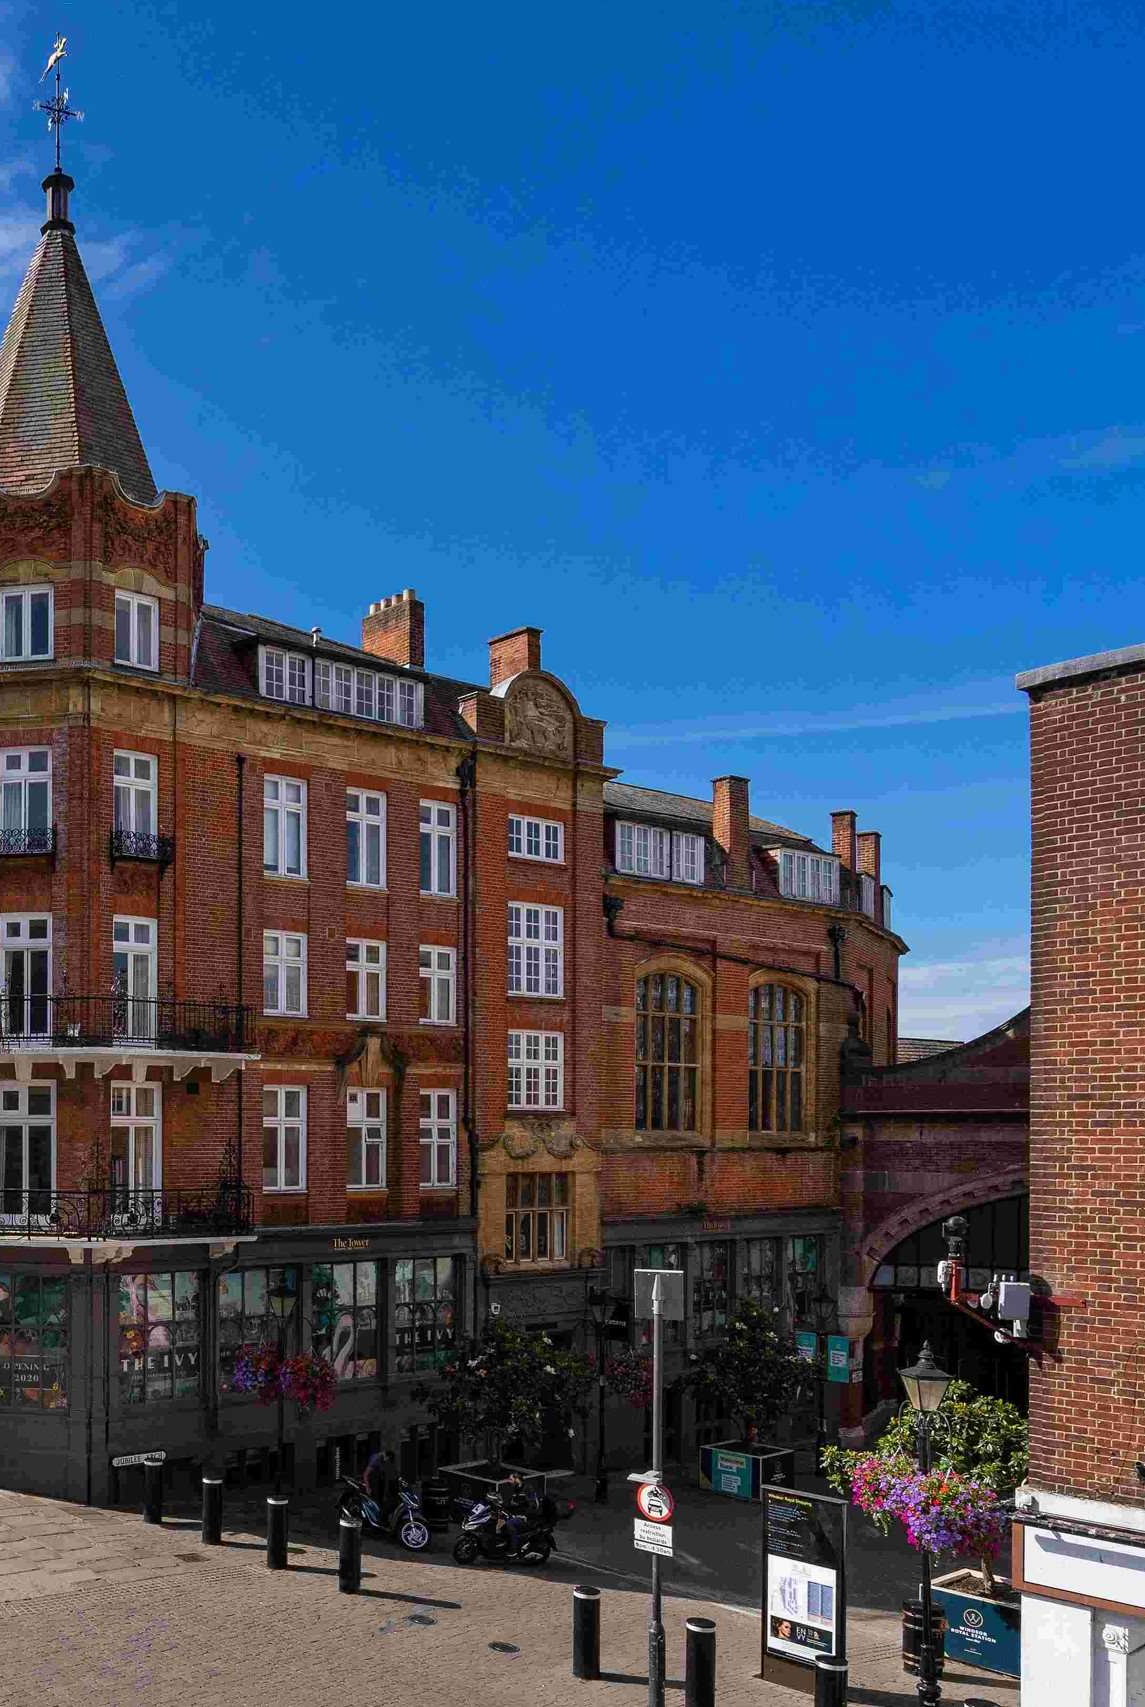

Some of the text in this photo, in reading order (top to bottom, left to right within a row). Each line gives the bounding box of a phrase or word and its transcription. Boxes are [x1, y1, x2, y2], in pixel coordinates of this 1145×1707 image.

[332, 1238, 346, 1249] The
[395, 1328, 455, 1345] THE IVY
[120, 1351, 198, 1373] THE IVY
[14, 1373, 40, 1383] 2020
[951, 1628, 969, 1637] ROYAL
[971, 1633, 997, 1644] STATION
[959, 1626, 987, 1637] WINDSOR
